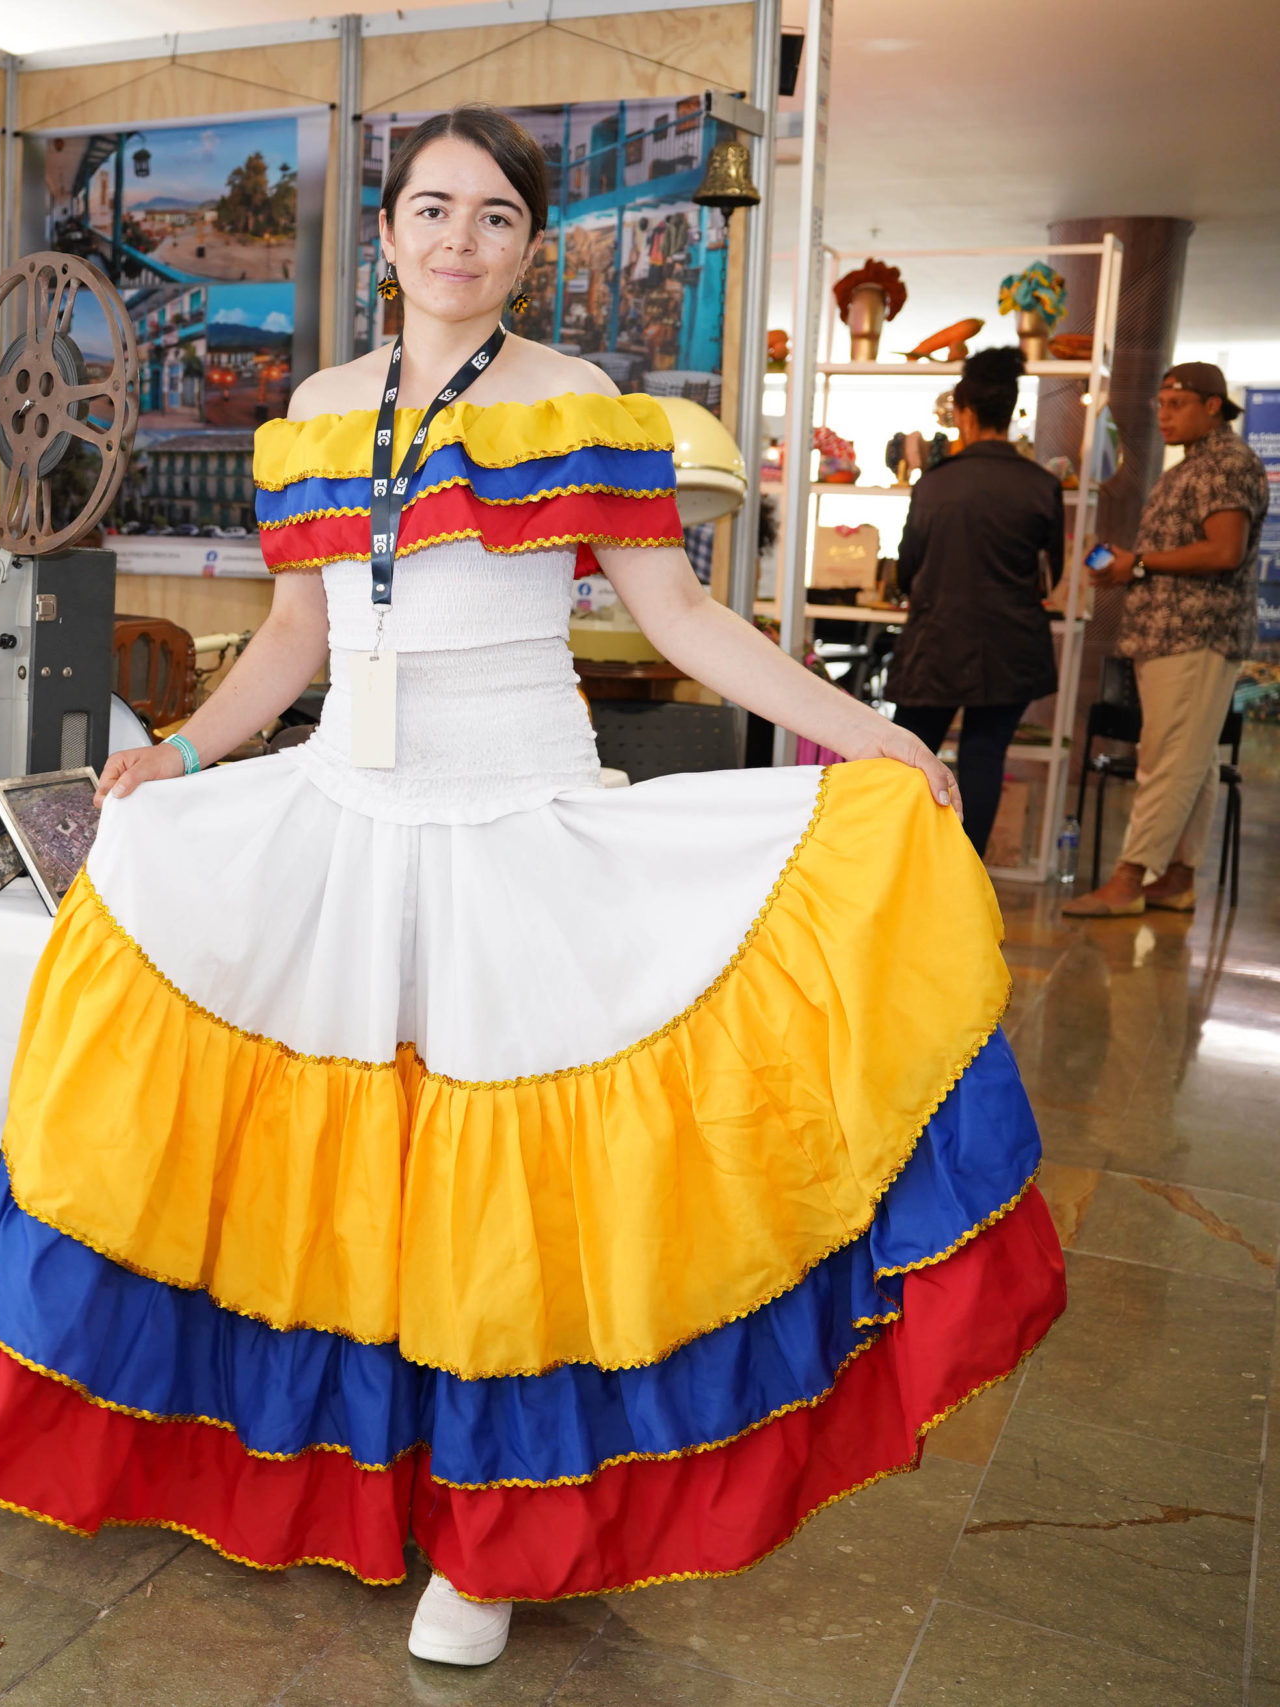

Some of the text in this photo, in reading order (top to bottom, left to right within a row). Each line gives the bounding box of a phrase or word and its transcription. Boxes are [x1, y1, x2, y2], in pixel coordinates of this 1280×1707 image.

[471, 351, 489, 370] EC
[385, 387, 397, 403] EC
[438, 388, 457, 401] EC
[377, 429, 391, 446] EC
[413, 426, 427, 444] EC
[373, 478, 387, 497] EC
[392, 476, 408, 495] EC
[373, 534, 387, 554] EC
